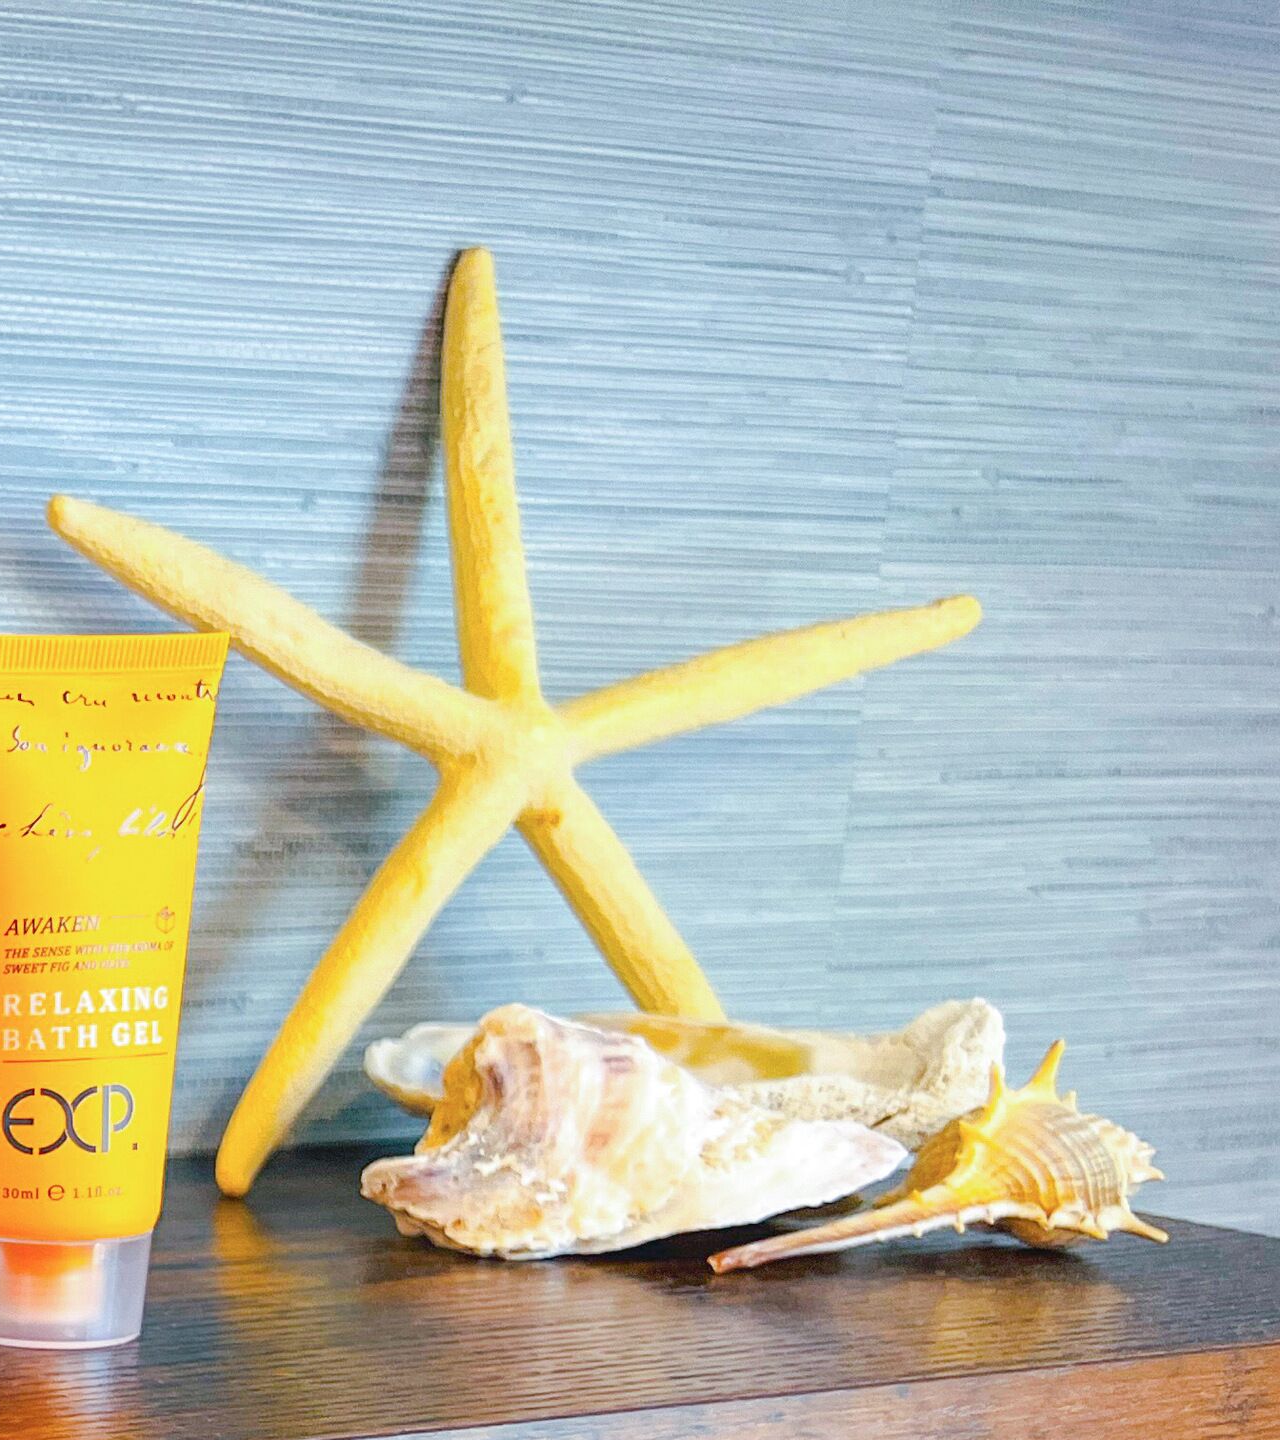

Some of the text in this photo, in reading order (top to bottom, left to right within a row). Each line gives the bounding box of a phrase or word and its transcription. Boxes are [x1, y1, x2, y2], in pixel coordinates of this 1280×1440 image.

[4, 915, 100, 936] AWAKEN
[4, 948, 29, 959] THE
[32, 946, 71, 958] SENSE
[3, 963, 44, 975] SWEET
[50, 961, 70, 973] FIG
[2, 985, 169, 1017] RELAXING
[2, 1020, 163, 1051] BATH GEL
[2, 1187, 39, 1199] 30ml
